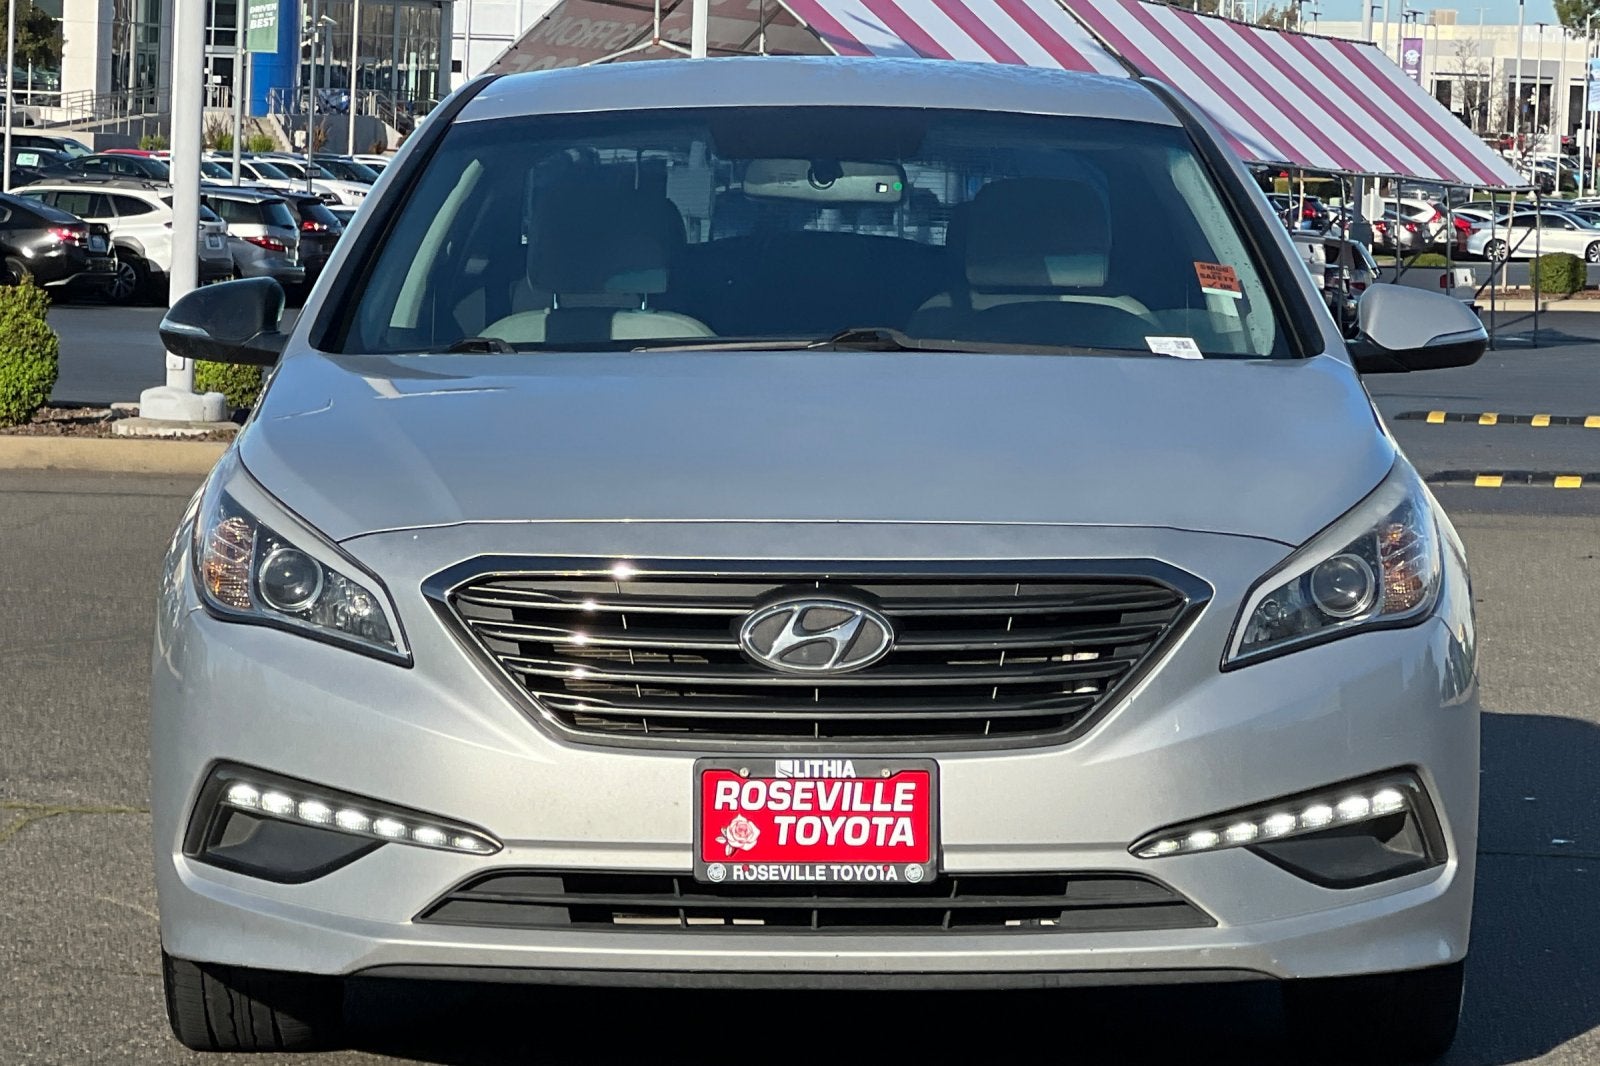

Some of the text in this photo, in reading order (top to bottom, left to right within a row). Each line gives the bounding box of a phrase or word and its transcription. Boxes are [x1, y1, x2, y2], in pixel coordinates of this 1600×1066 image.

[250, 3, 277, 13] DRIVEN
[250, 17, 275, 30] BEST
[1199, 273, 1235, 282] SAFETY
[794, 760, 856, 778] LITHIA
[715, 780, 917, 811] ROSEVILLE
[774, 816, 915, 846] TOYOTA
[733, 865, 897, 881] ROSEVILLE TOYOTA
